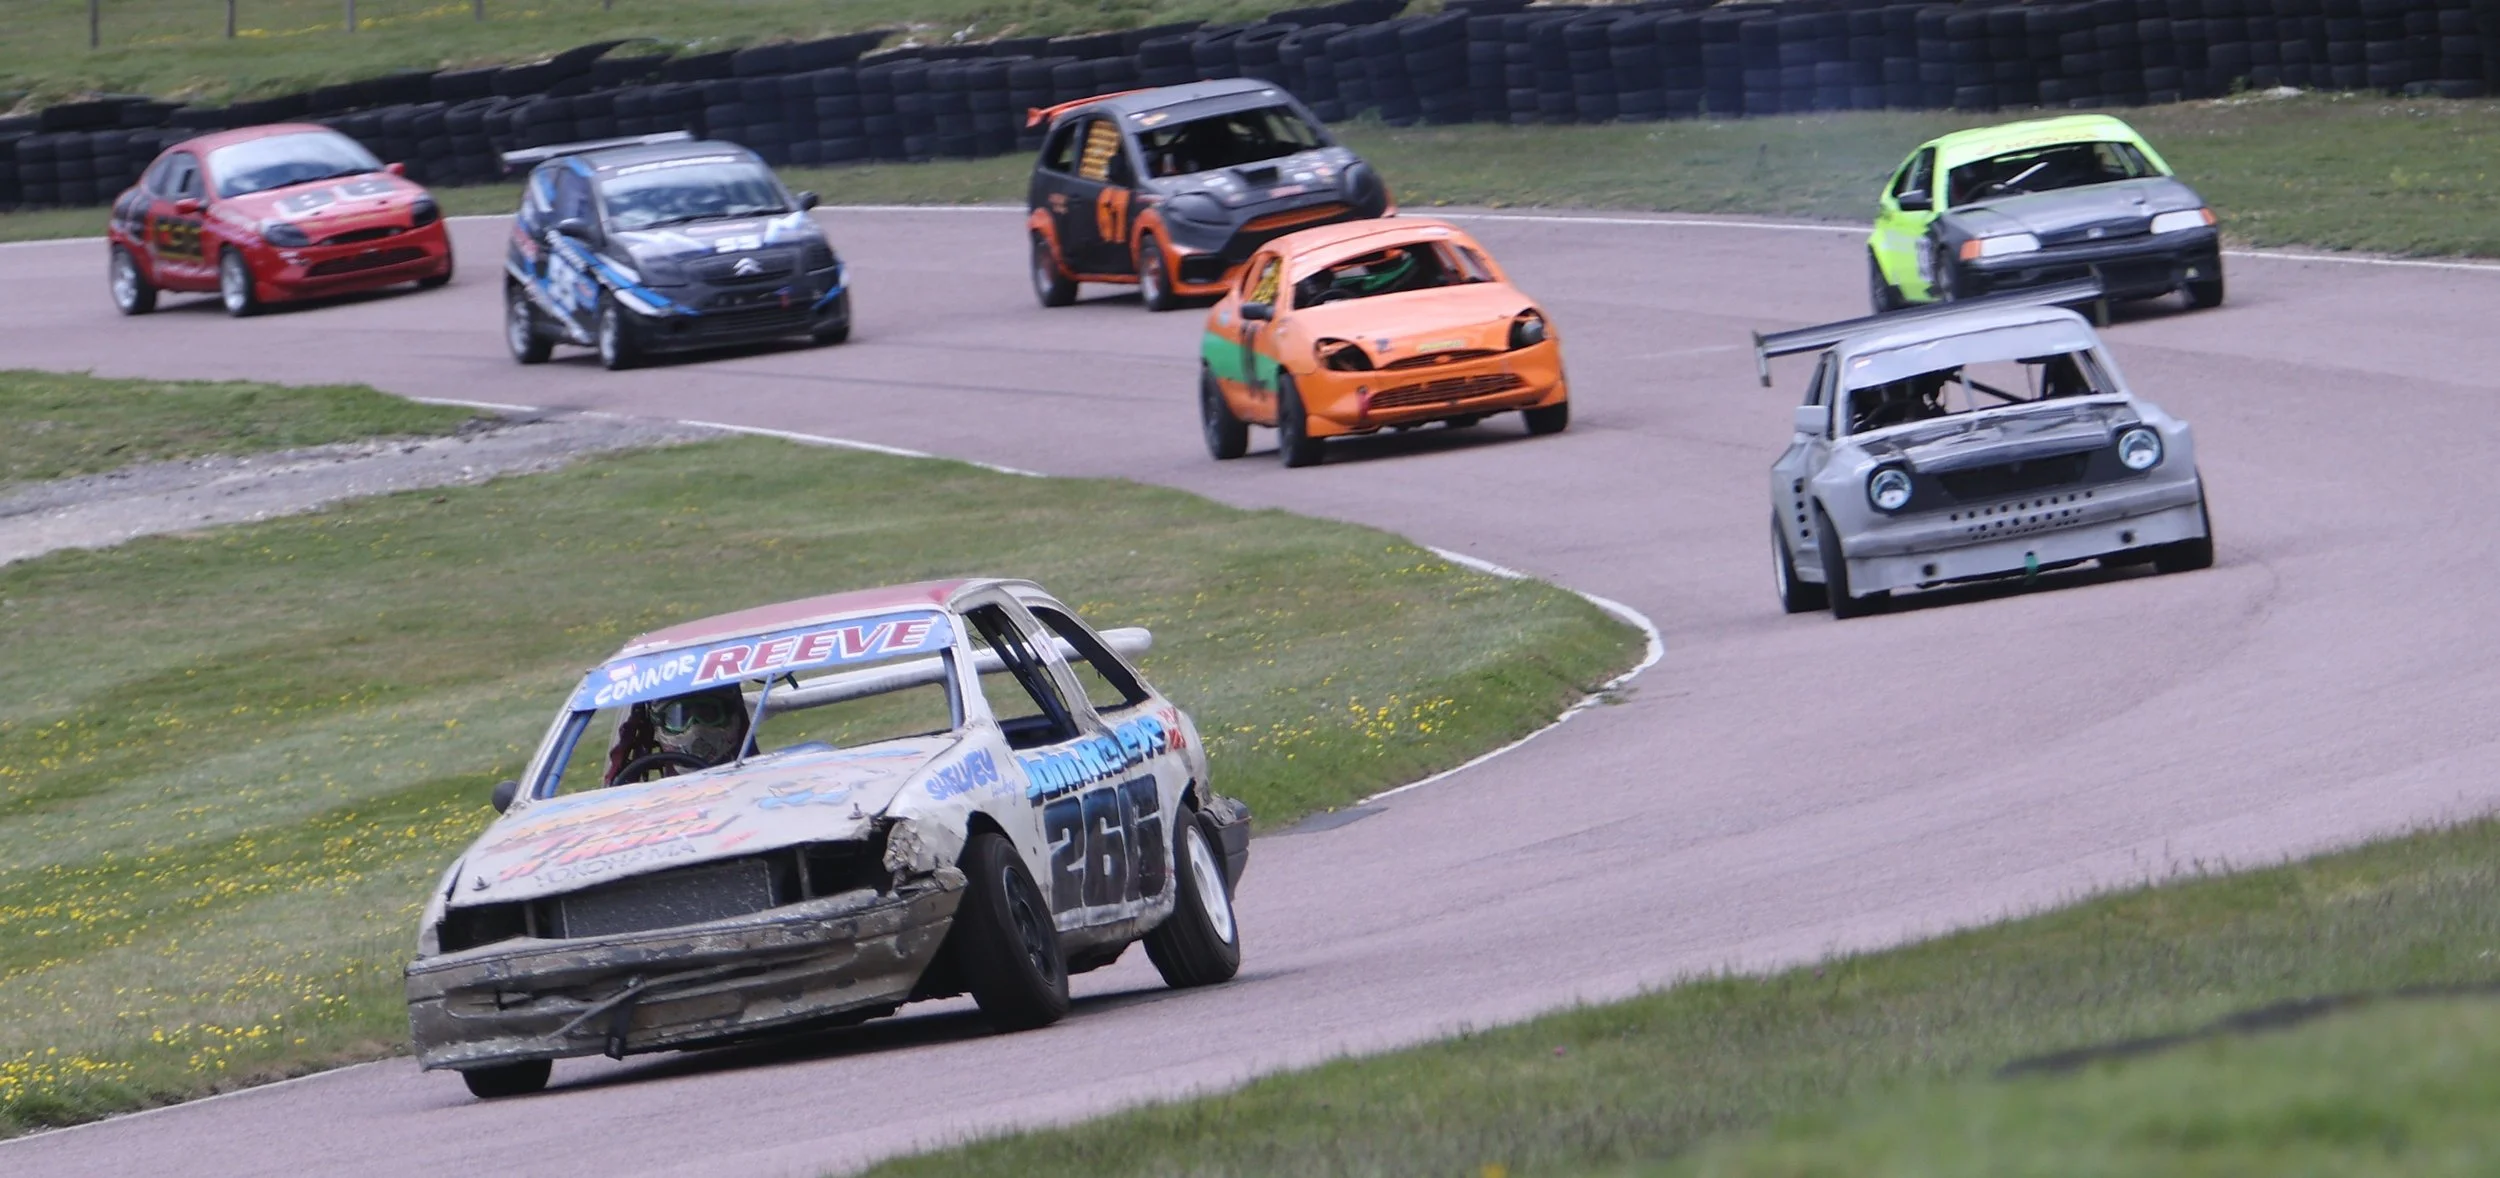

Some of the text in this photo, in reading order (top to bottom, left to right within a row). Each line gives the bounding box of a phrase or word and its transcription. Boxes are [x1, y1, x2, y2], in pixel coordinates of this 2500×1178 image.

[594, 618, 935, 705] CONNOR REEVE
[1043, 773, 1167, 915] 266
